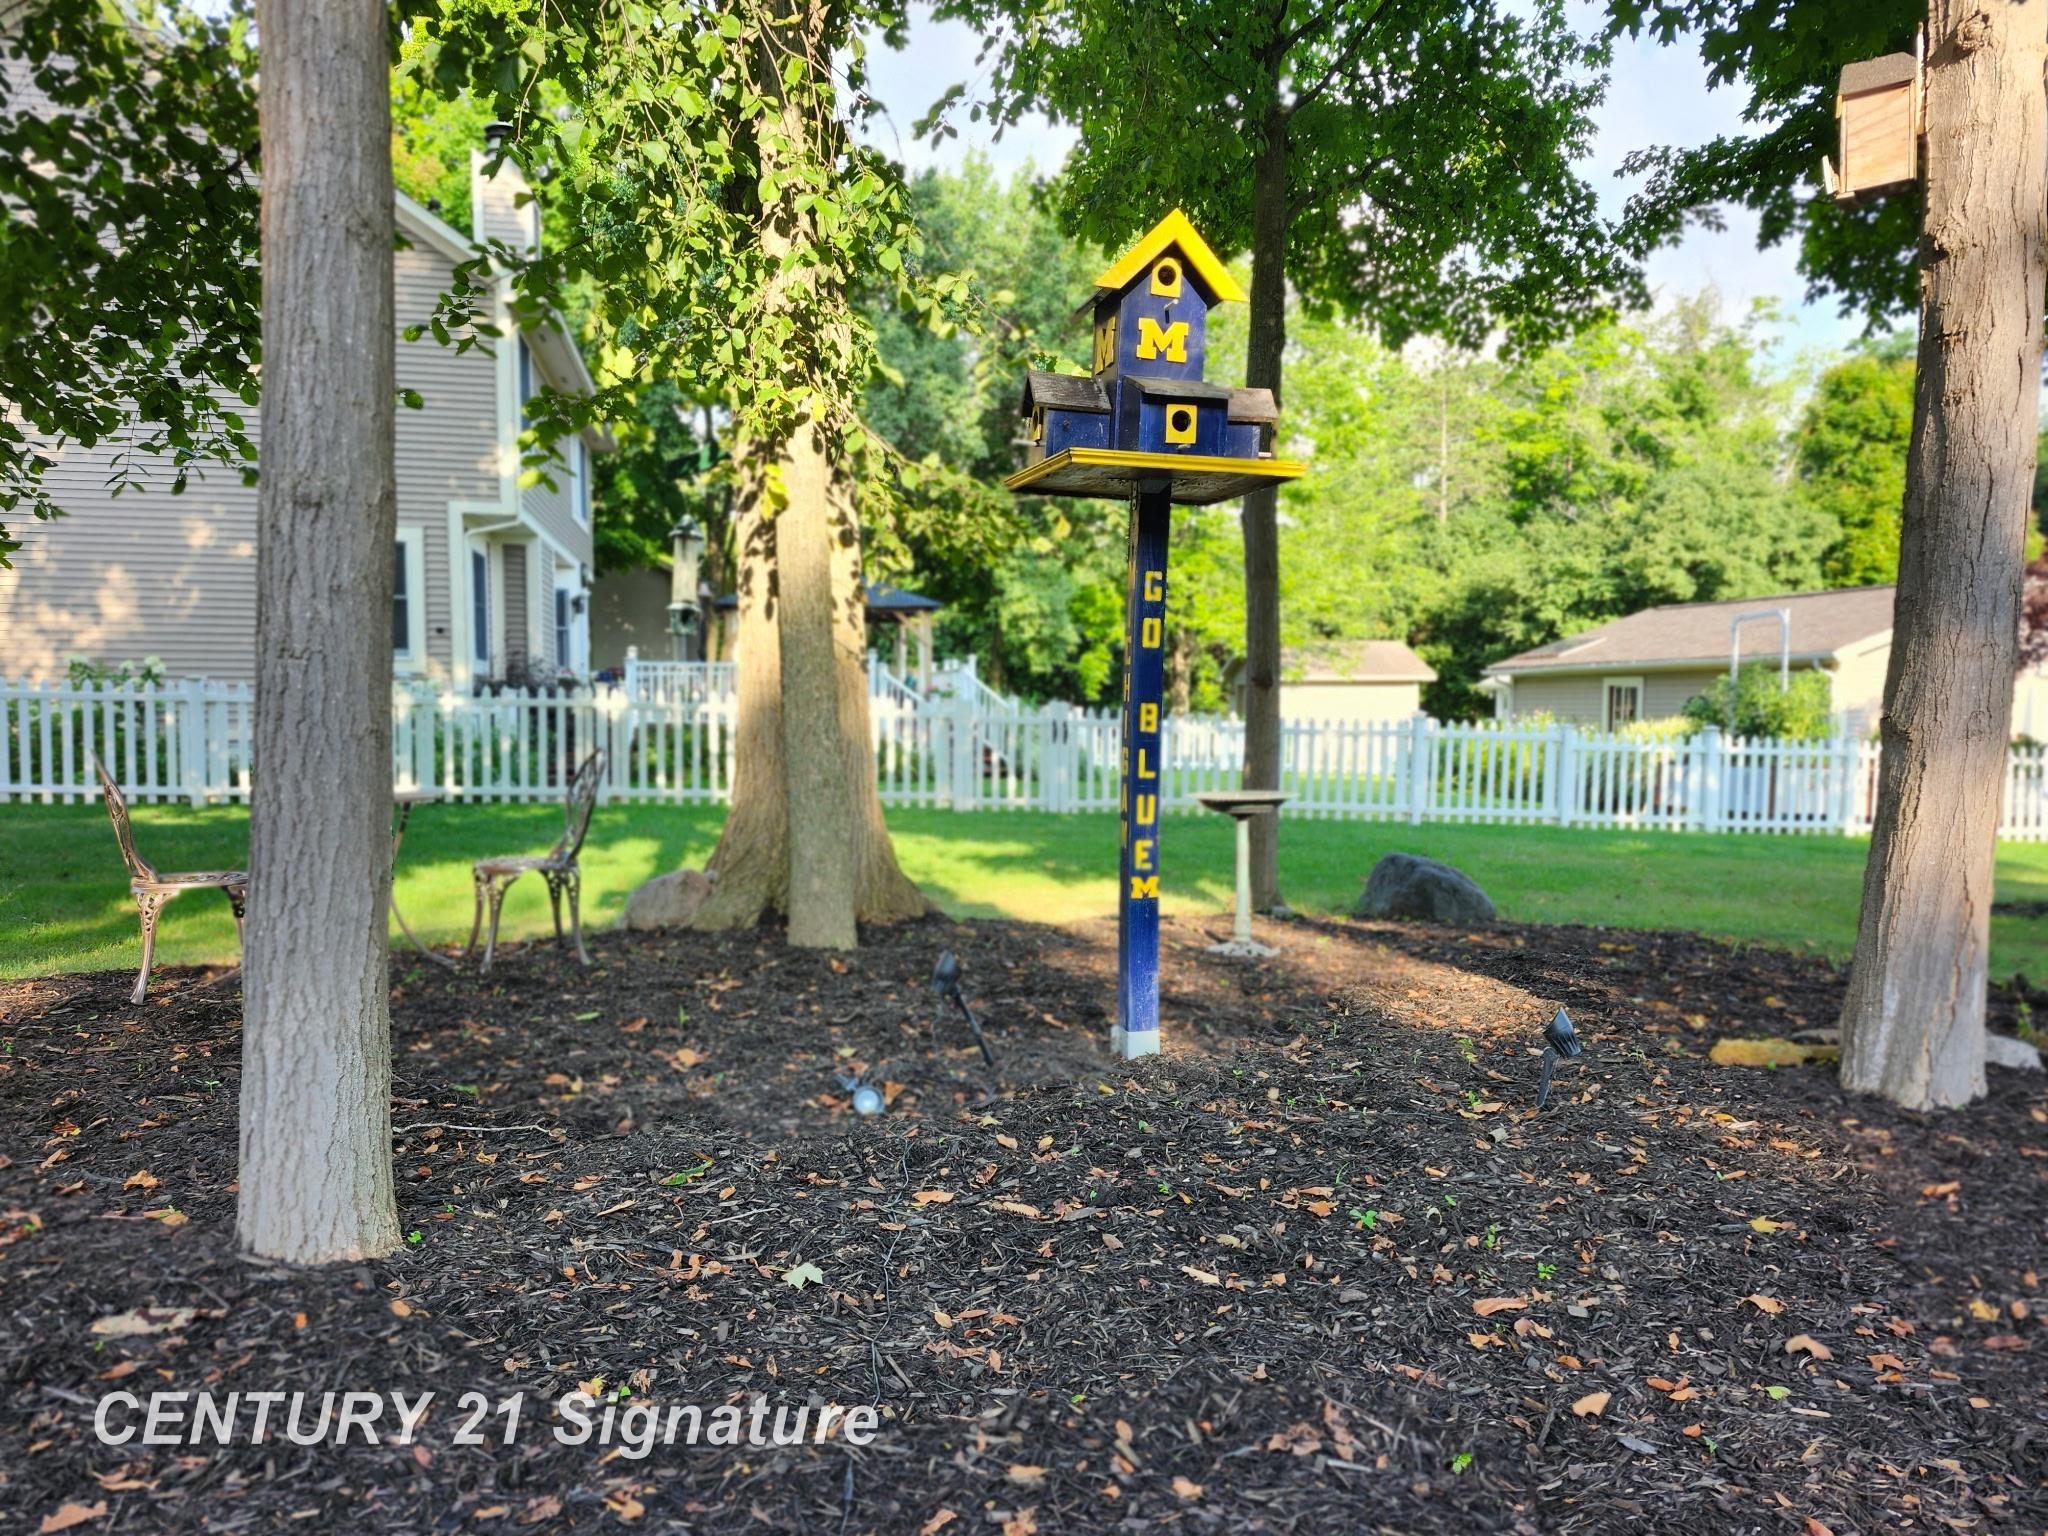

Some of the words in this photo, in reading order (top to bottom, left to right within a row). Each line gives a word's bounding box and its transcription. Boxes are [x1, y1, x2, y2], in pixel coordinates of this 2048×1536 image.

[1095, 316, 1116, 375] M
[1136, 318, 1189, 363] M
[1142, 570, 1163, 649] GO
[1134, 702, 1159, 870] BLUE
